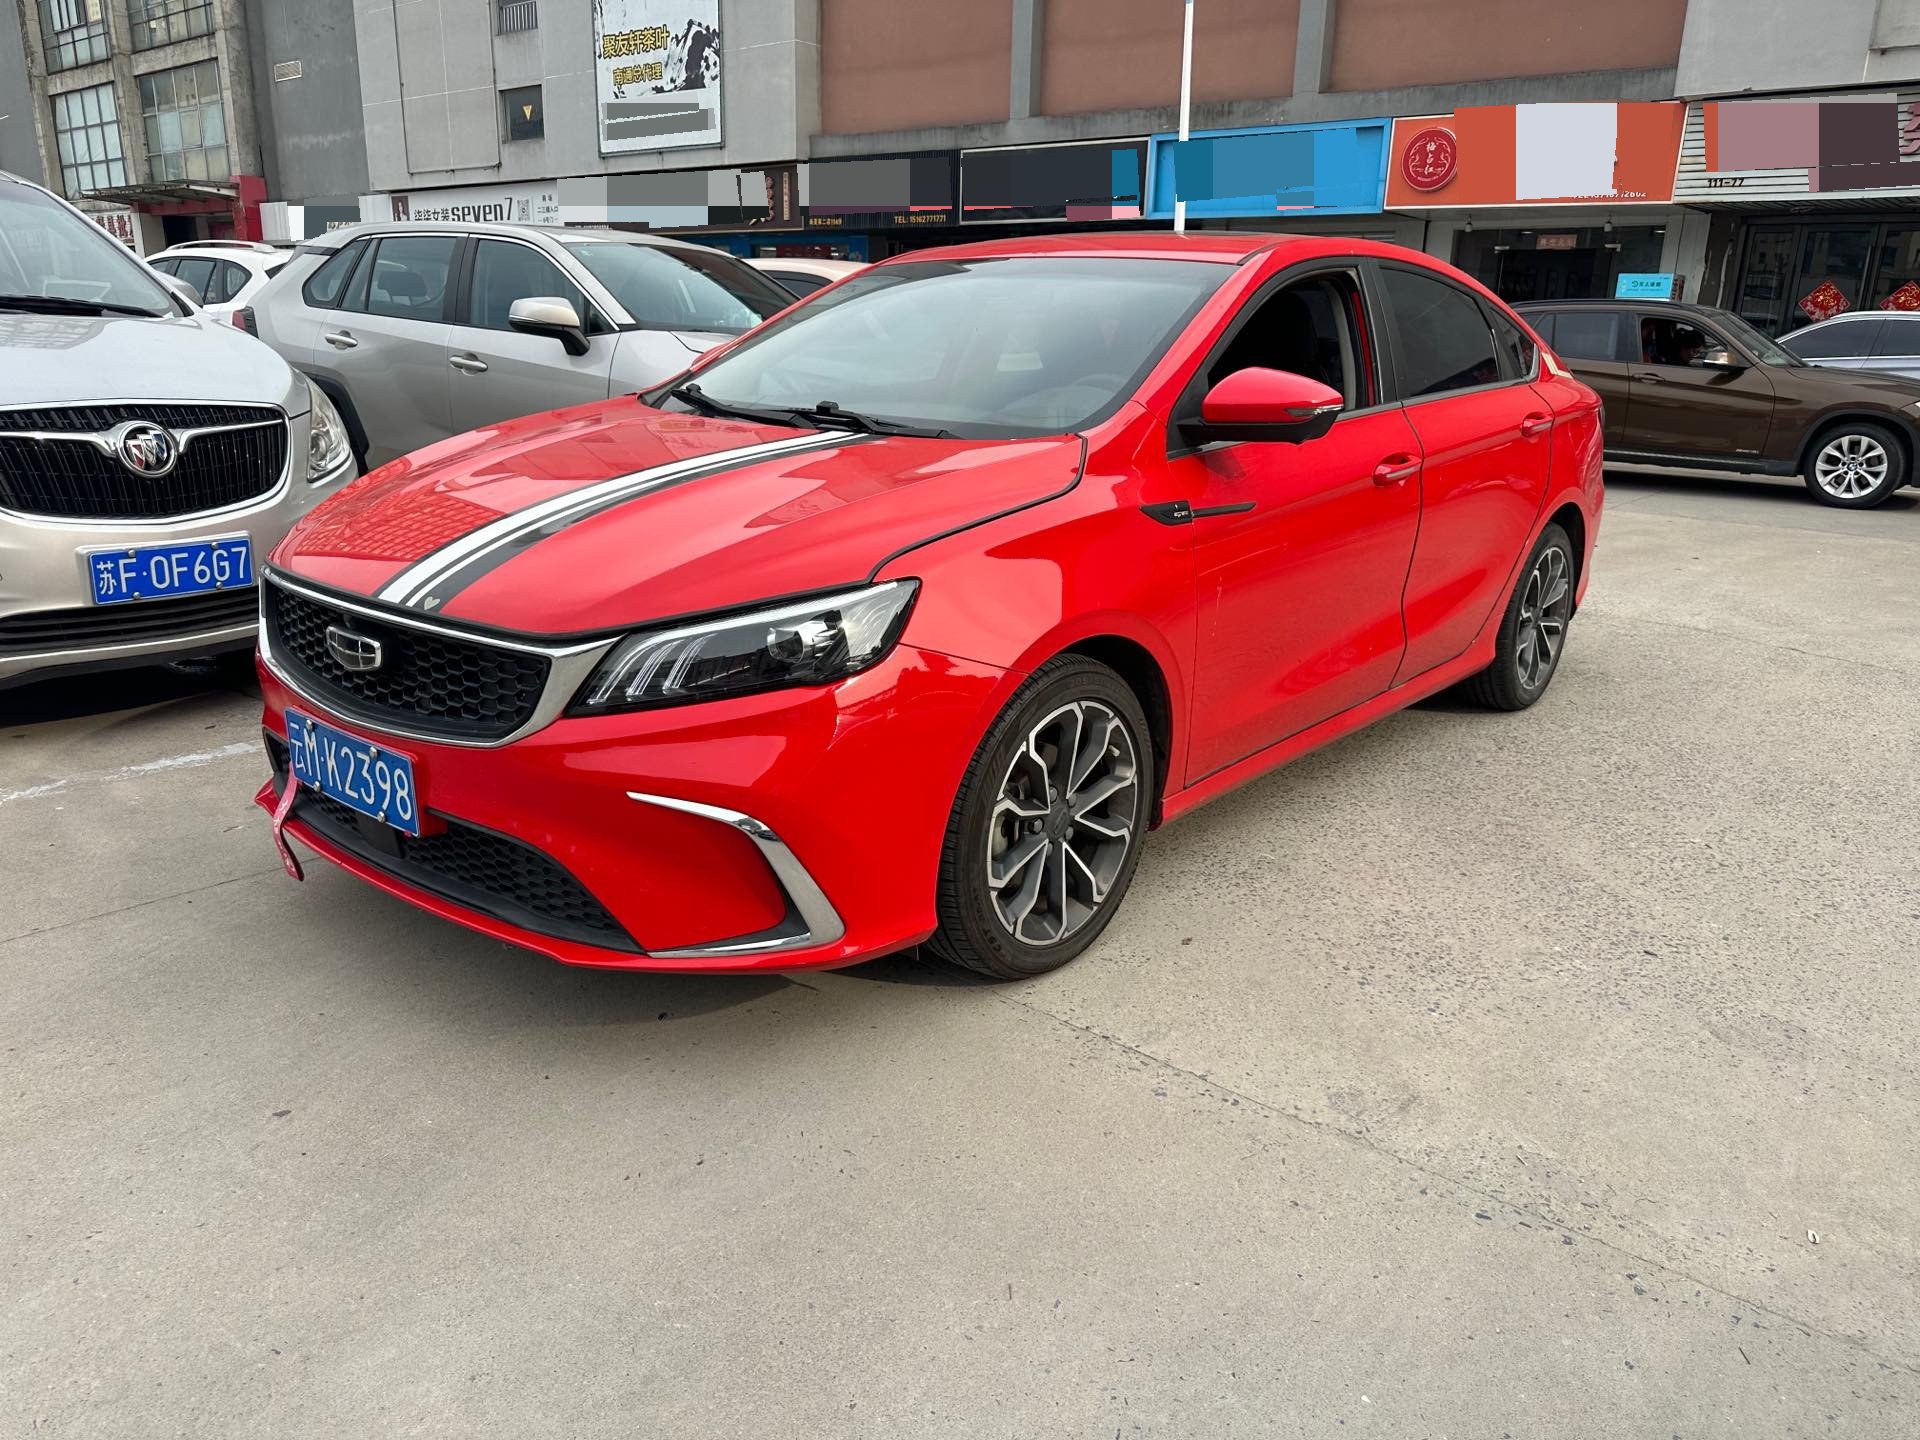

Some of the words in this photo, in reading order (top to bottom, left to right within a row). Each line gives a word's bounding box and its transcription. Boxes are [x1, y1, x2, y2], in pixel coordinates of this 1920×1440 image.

[602, 23, 670, 60] 聚友轩茶叶
[612, 61, 663, 86] 南通总代理
[1707, 177, 1744, 188] 111-77
[290, 722, 412, 820] 云M·K2398
